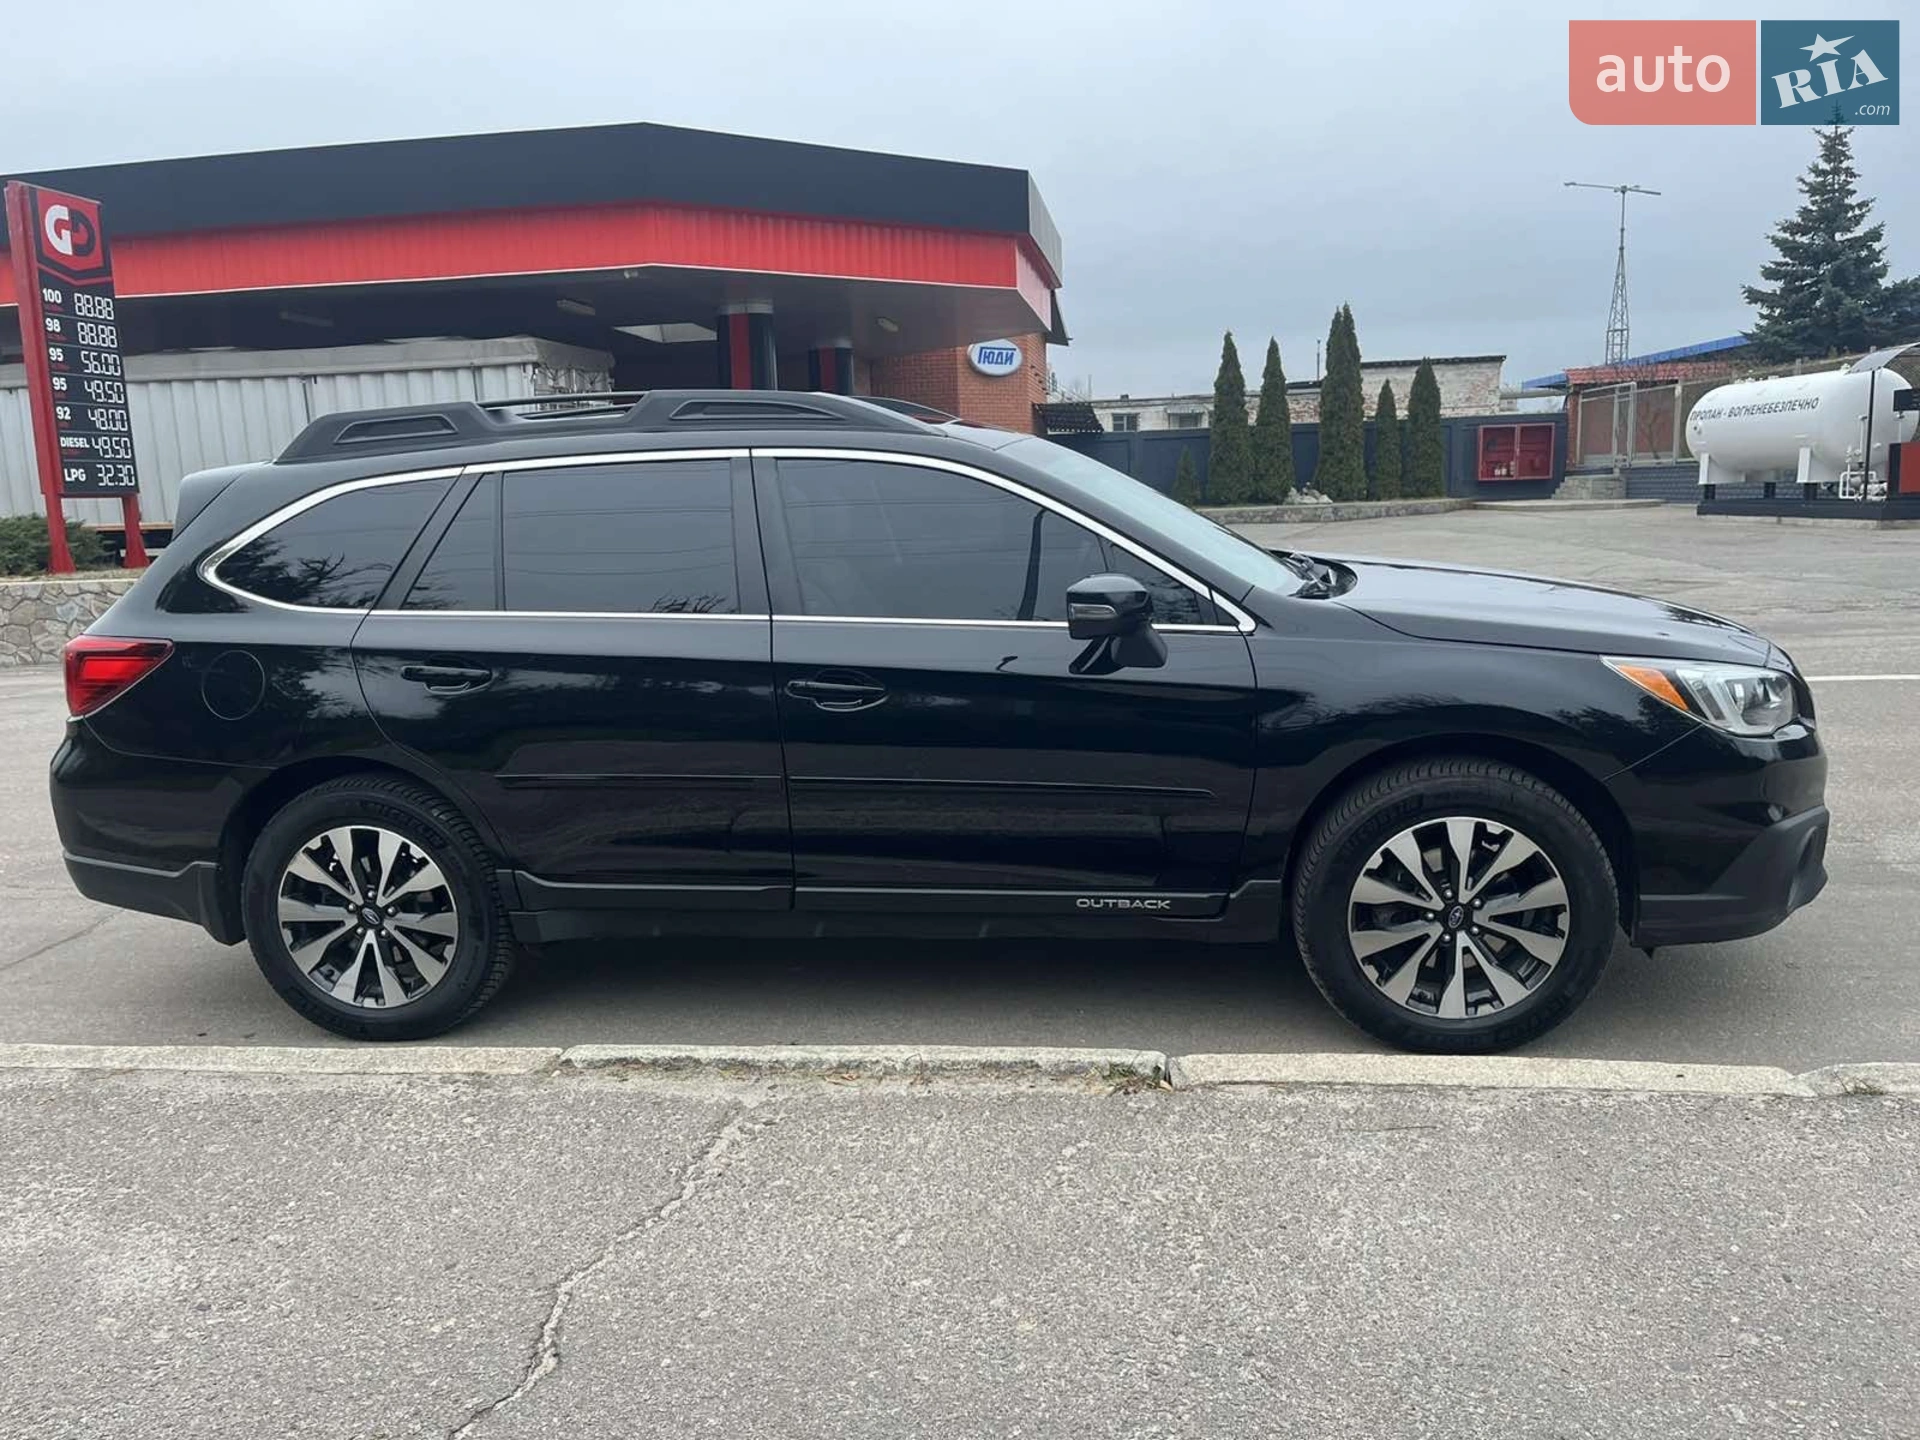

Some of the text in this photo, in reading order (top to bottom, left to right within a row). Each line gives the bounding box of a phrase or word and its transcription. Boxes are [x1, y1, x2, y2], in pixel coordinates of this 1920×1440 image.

[42, 287, 62, 304] 100
[74, 293, 115, 320] 88.88
[45, 317, 118, 348] 98 88.88
[48, 347, 64, 362] 95
[81, 351, 121, 376] 56.00
[52, 376, 125, 404] 95 49.50
[56, 406, 128, 431] 92 48.00
[1690, 407, 1723, 421] ПРОПАН
[60, 437, 90, 448] DIESEL
[91, 436, 132, 459] 49.50
[64, 464, 135, 486] LPG 32.30
[1075, 898, 1172, 910] OUTBACK
